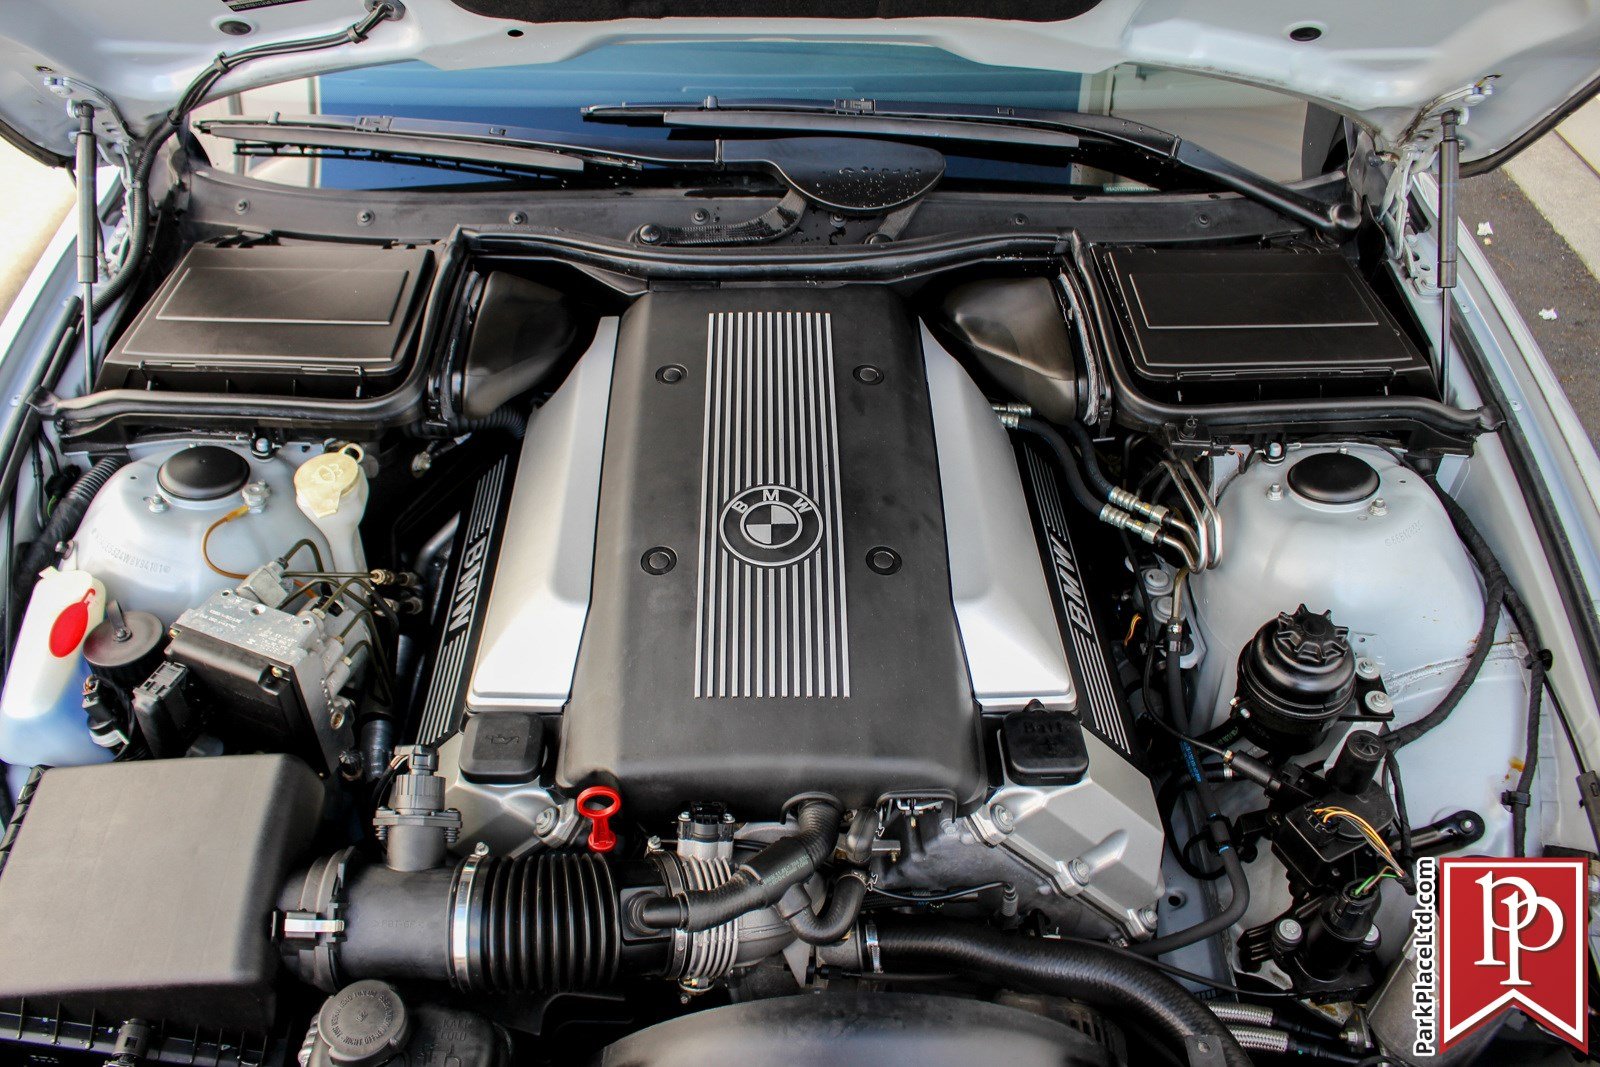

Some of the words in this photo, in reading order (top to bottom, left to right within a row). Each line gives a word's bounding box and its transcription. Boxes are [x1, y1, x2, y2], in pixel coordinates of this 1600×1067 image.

[731, 489, 813, 514] BMW
[449, 536, 487, 631] BMW
[1050, 533, 1092, 635] BMW
